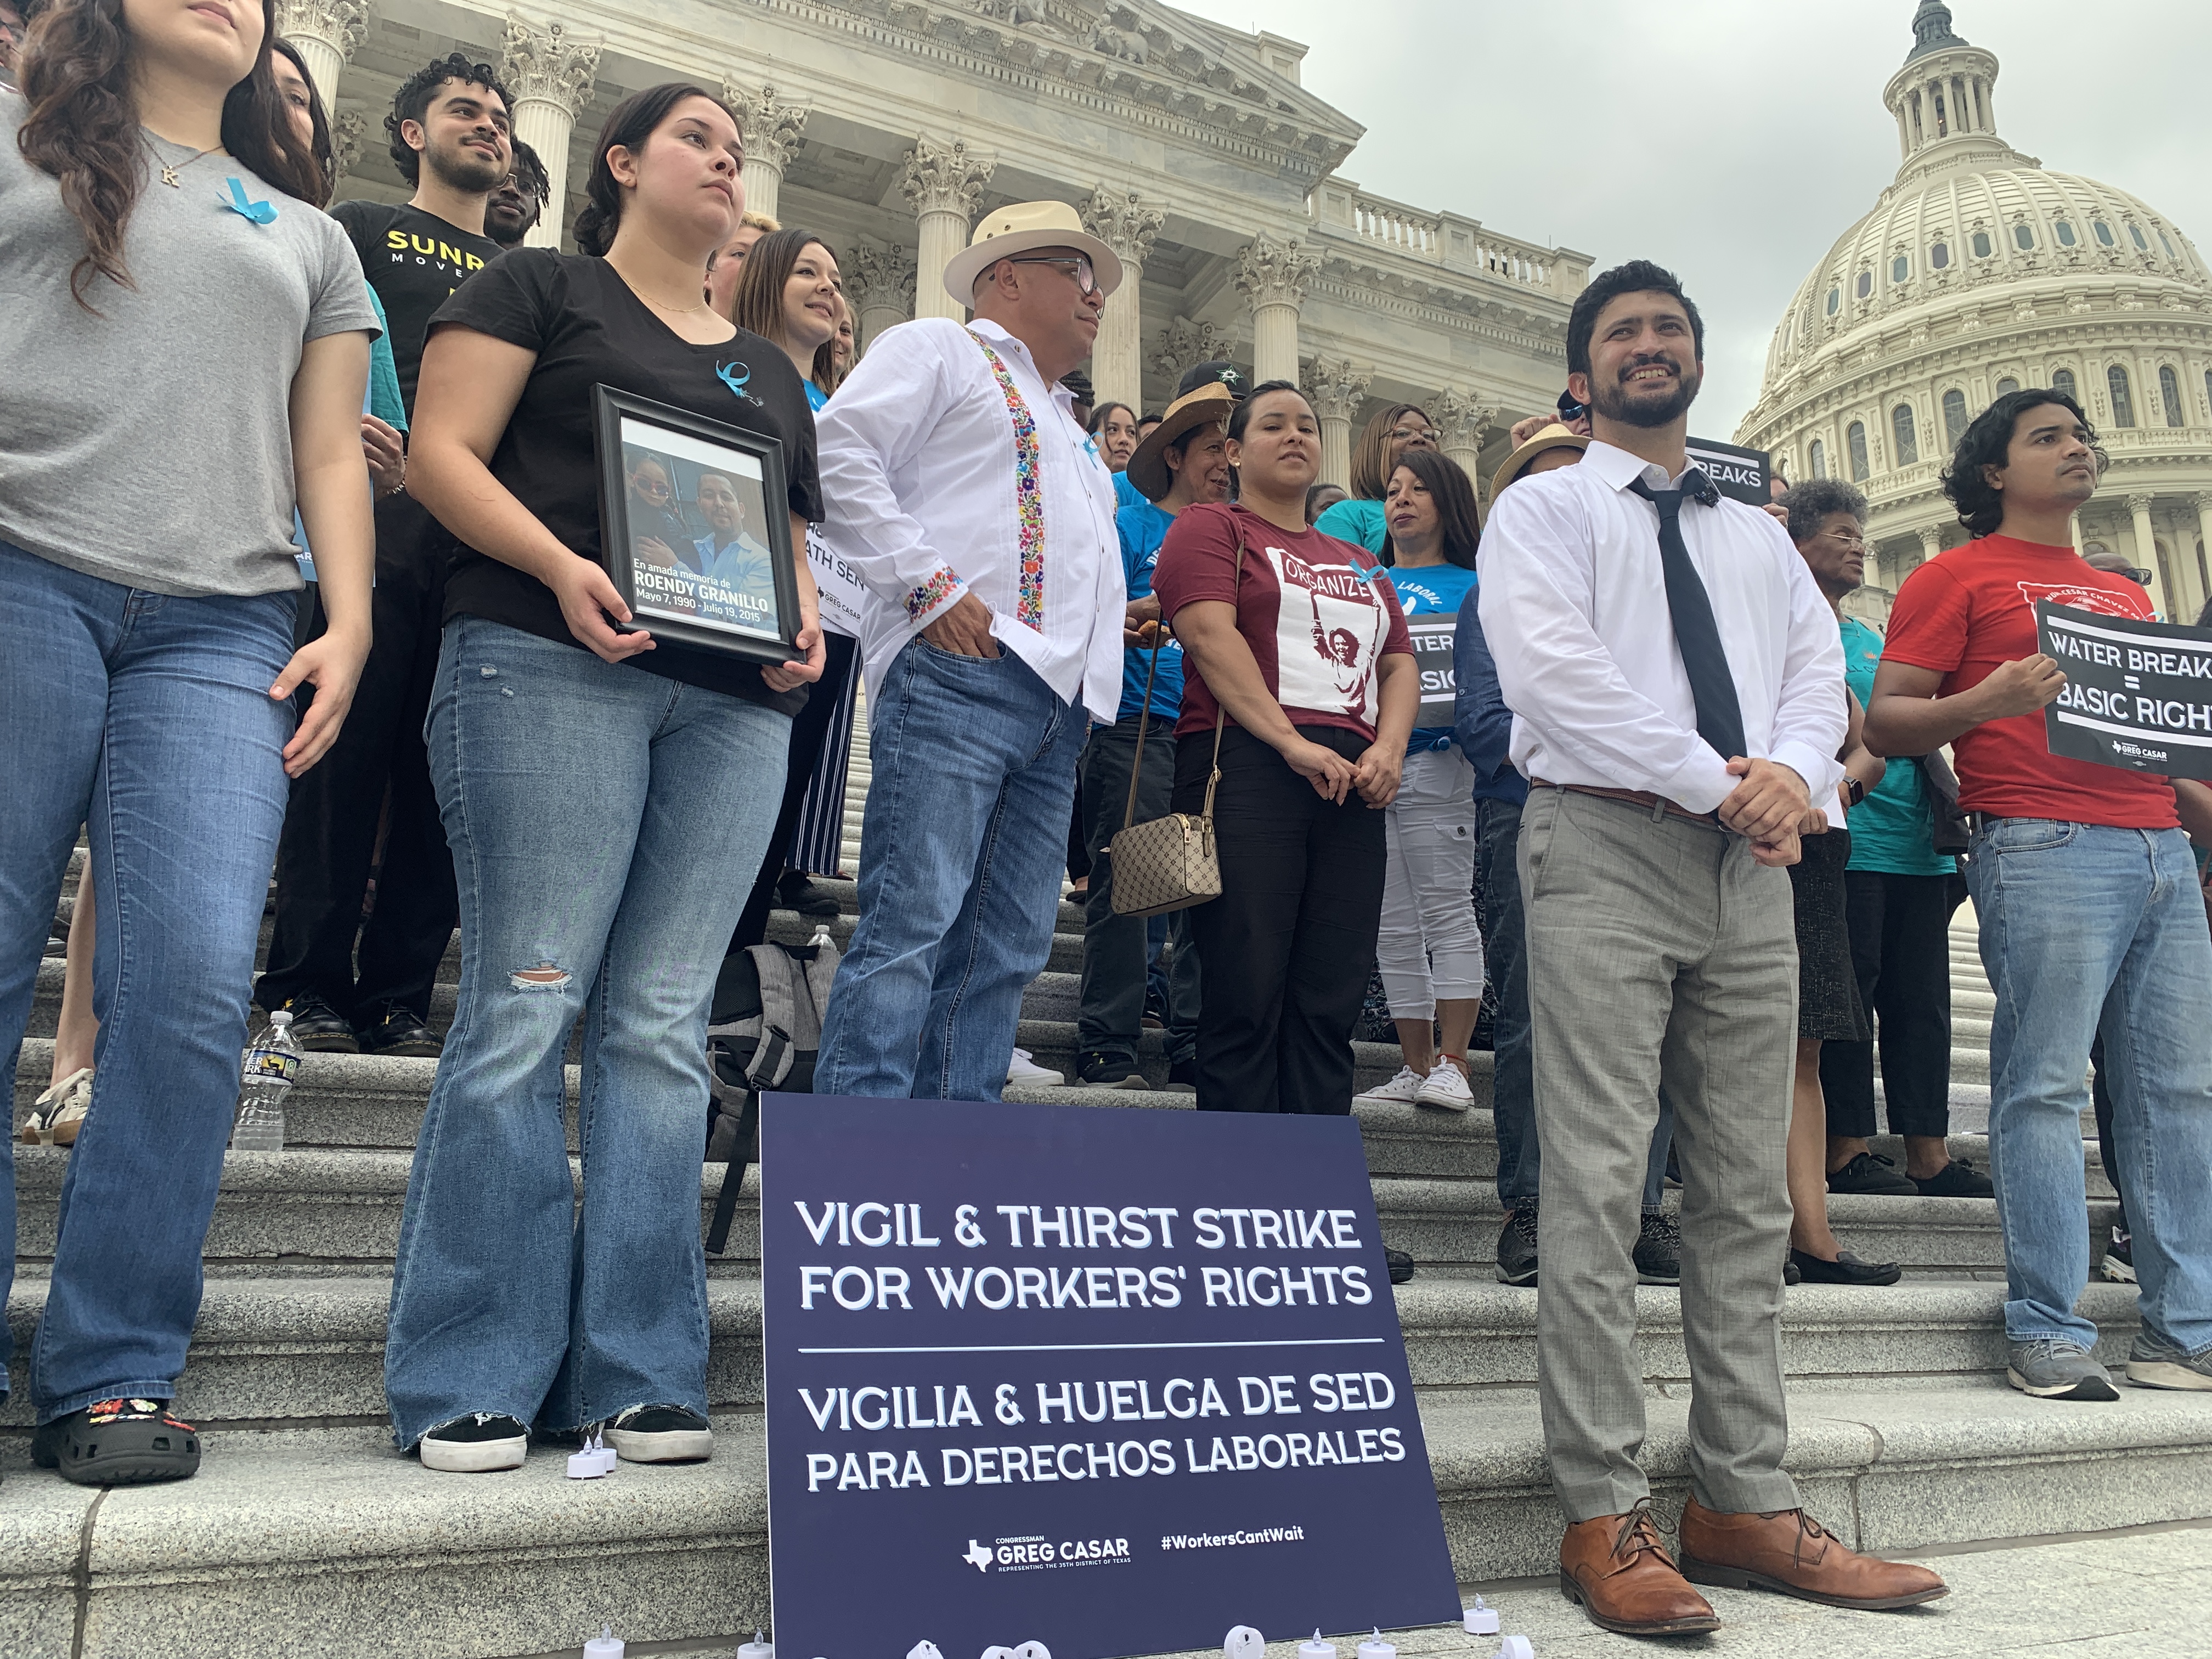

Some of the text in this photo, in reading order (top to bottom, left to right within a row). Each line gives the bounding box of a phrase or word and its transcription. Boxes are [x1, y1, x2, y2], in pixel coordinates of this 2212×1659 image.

[392, 253, 463, 278] MOVE
[634, 557, 731, 589] En amada memoria de
[1285, 558, 1370, 597] ORGANIZE
[634, 569, 769, 612] ROENDY GRANILLO
[636, 587, 662, 602] Mayo
[663, 592, 672, 605] 7,
[673, 595, 696, 608] 1990
[703, 601, 723, 614] Julio
[724, 606, 738, 619] 19,
[739, 609, 760, 622] 2015
[1397, 581, 1443, 606] LABORAL
[2090, 592, 2129, 613] CHAVEZ
[825, 594, 841, 608] GREG
[842, 605, 861, 621] CASAR
[2048, 631, 2212, 679] WATER BREAK
[2056, 682, 2212, 731] BASIC RIGH
[2122, 745, 2141, 755] GREG
[2142, 749, 2167, 759] CASAR
[794, 1201, 1362, 1249] VIGIL & THIRST STRIKE
[799, 1265, 1373, 1310] FOR WORKERS' RIGHTS
[798, 1372, 1396, 1432] VIGILIA & HUELGA DE SED
[806, 1427, 1406, 1492] PARA DERECHOS LABORALES
[996, 1535, 1045, 1544] CONGRESSMAN
[997, 1538, 1130, 1565] GREG CASAR
[1161, 1525, 1305, 1550] #WorkersCantWait
[998, 1564, 1043, 1572] REPRESENTING
